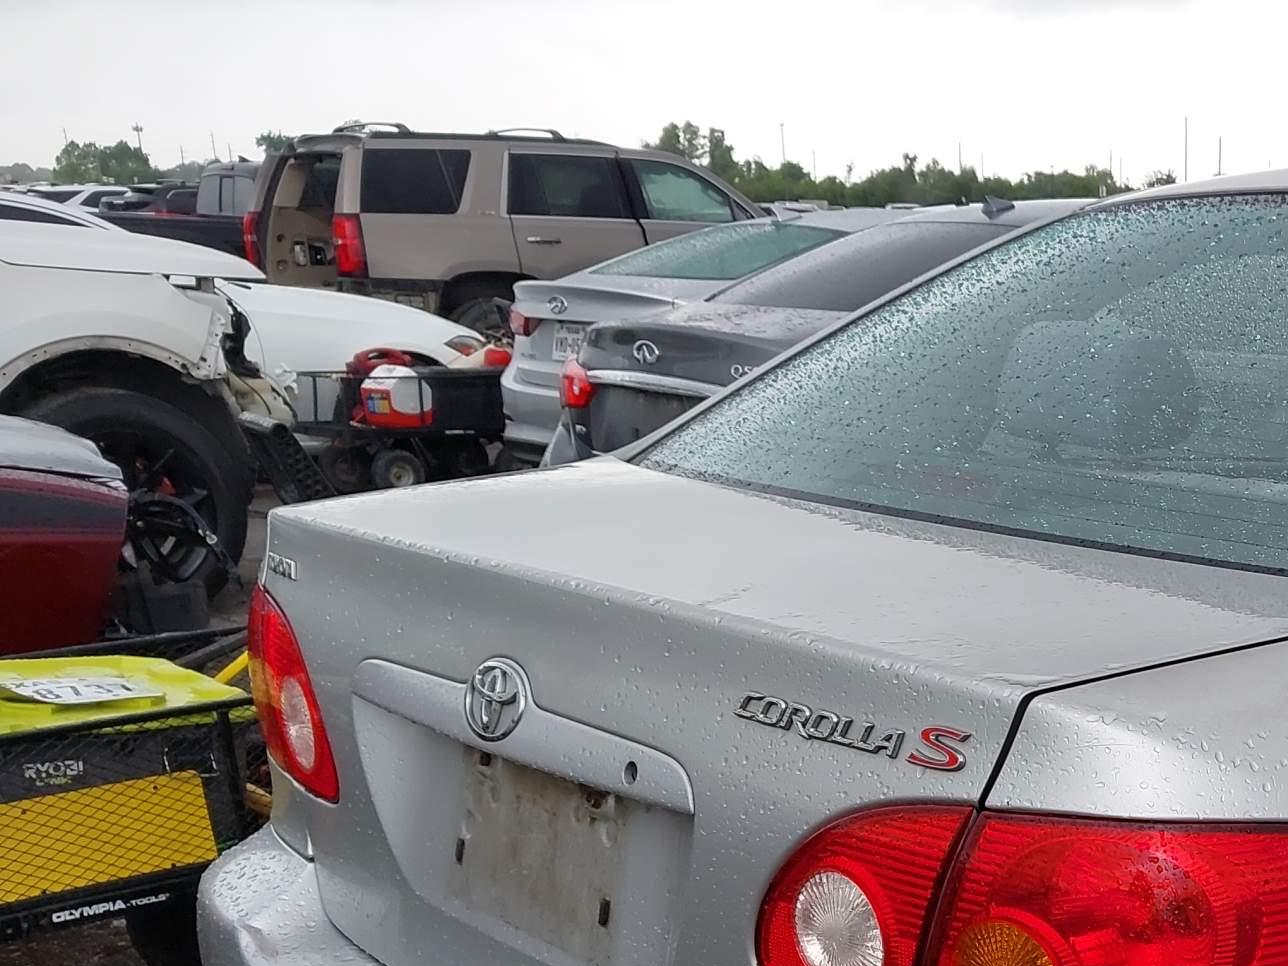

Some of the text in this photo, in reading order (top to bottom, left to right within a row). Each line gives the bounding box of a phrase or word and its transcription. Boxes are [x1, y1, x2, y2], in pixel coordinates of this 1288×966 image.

[733, 690, 973, 772] COROLLA S
[22, 760, 84, 779] RYOBI
